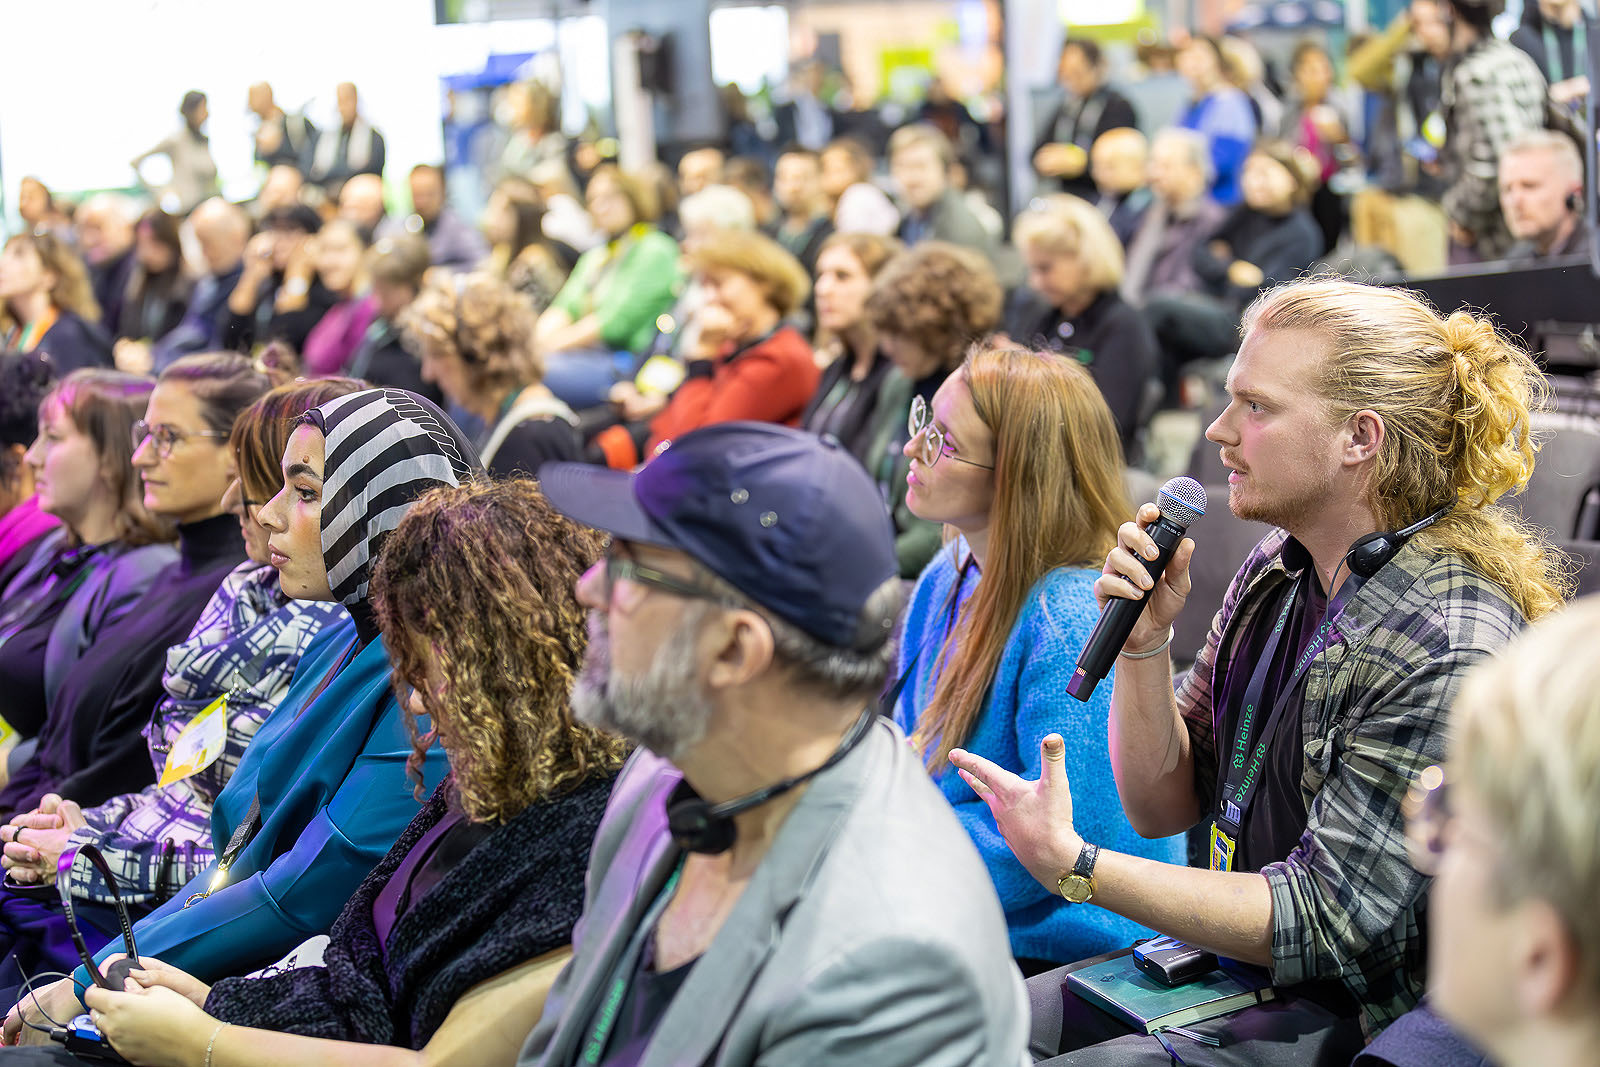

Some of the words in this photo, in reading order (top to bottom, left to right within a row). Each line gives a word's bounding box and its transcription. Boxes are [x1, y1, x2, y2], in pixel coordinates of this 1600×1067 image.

[1294, 635, 1324, 677] Heinze
[1236, 704, 1254, 751] Heinze
[1235, 759, 1260, 802] Heinze
